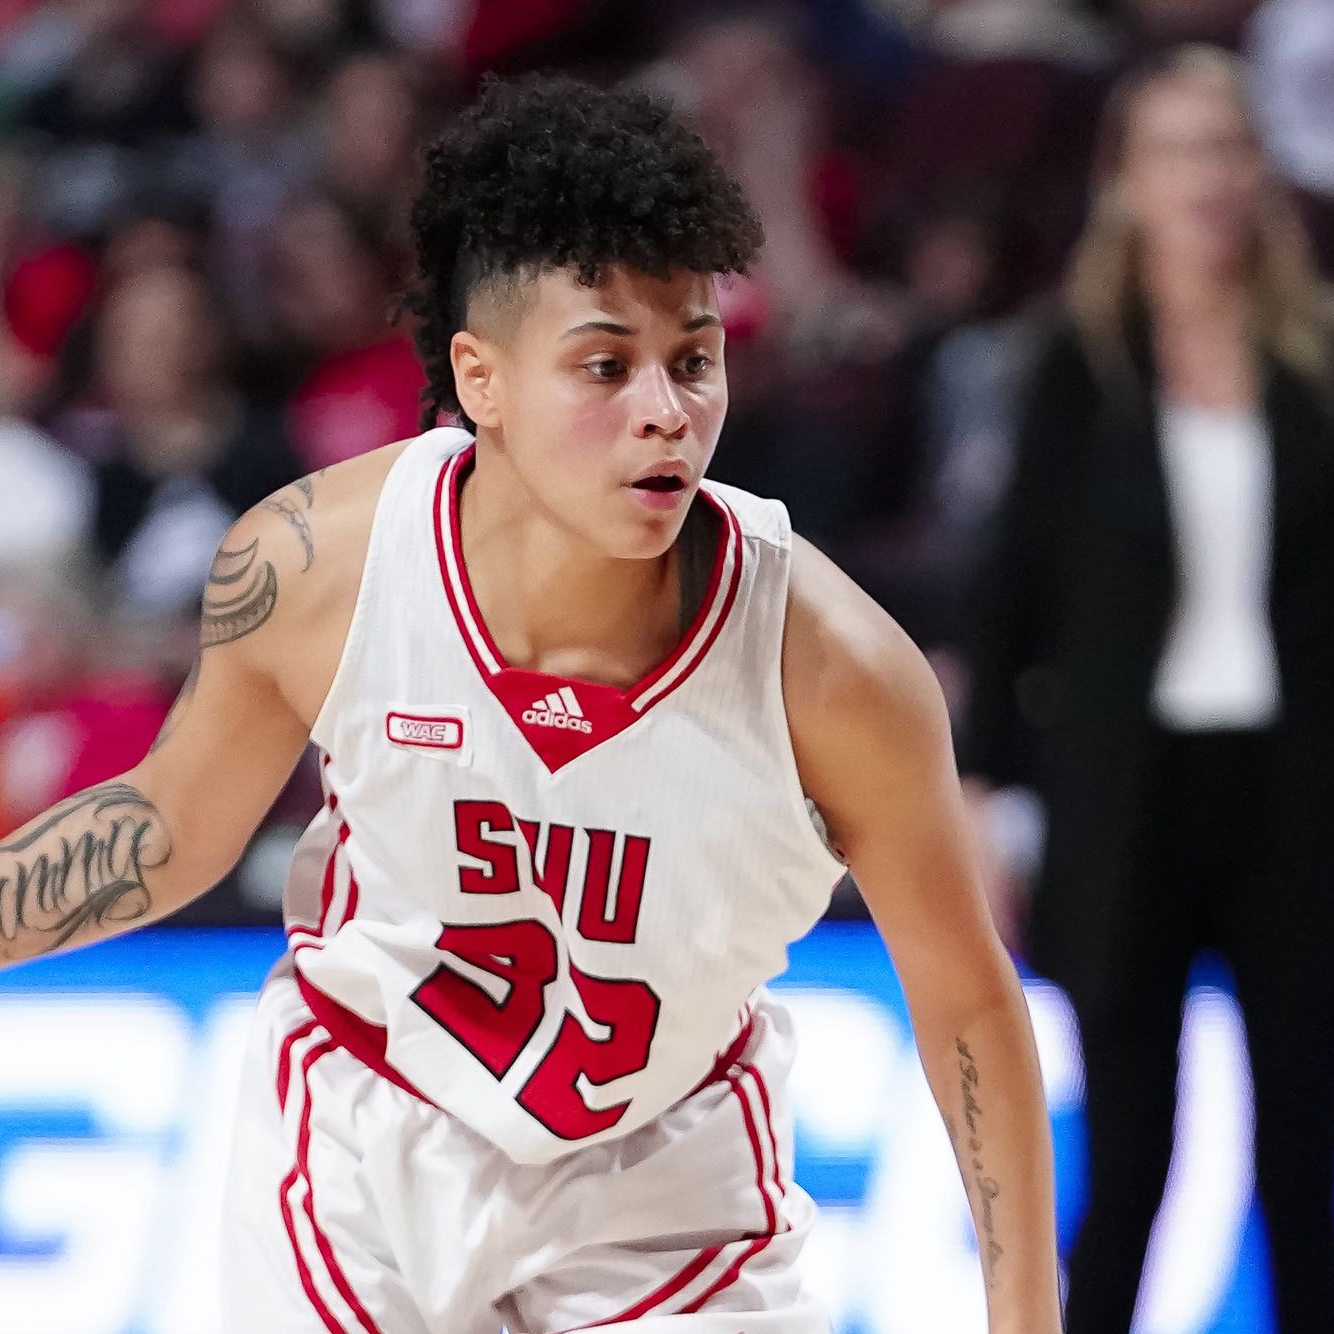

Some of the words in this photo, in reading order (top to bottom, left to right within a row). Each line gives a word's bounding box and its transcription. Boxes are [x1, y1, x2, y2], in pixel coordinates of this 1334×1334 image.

[401, 721, 447, 742] WAC
[522, 708, 593, 735] adidas
[454, 800, 652, 945] SUU
[409, 918, 662, 1141] 32
